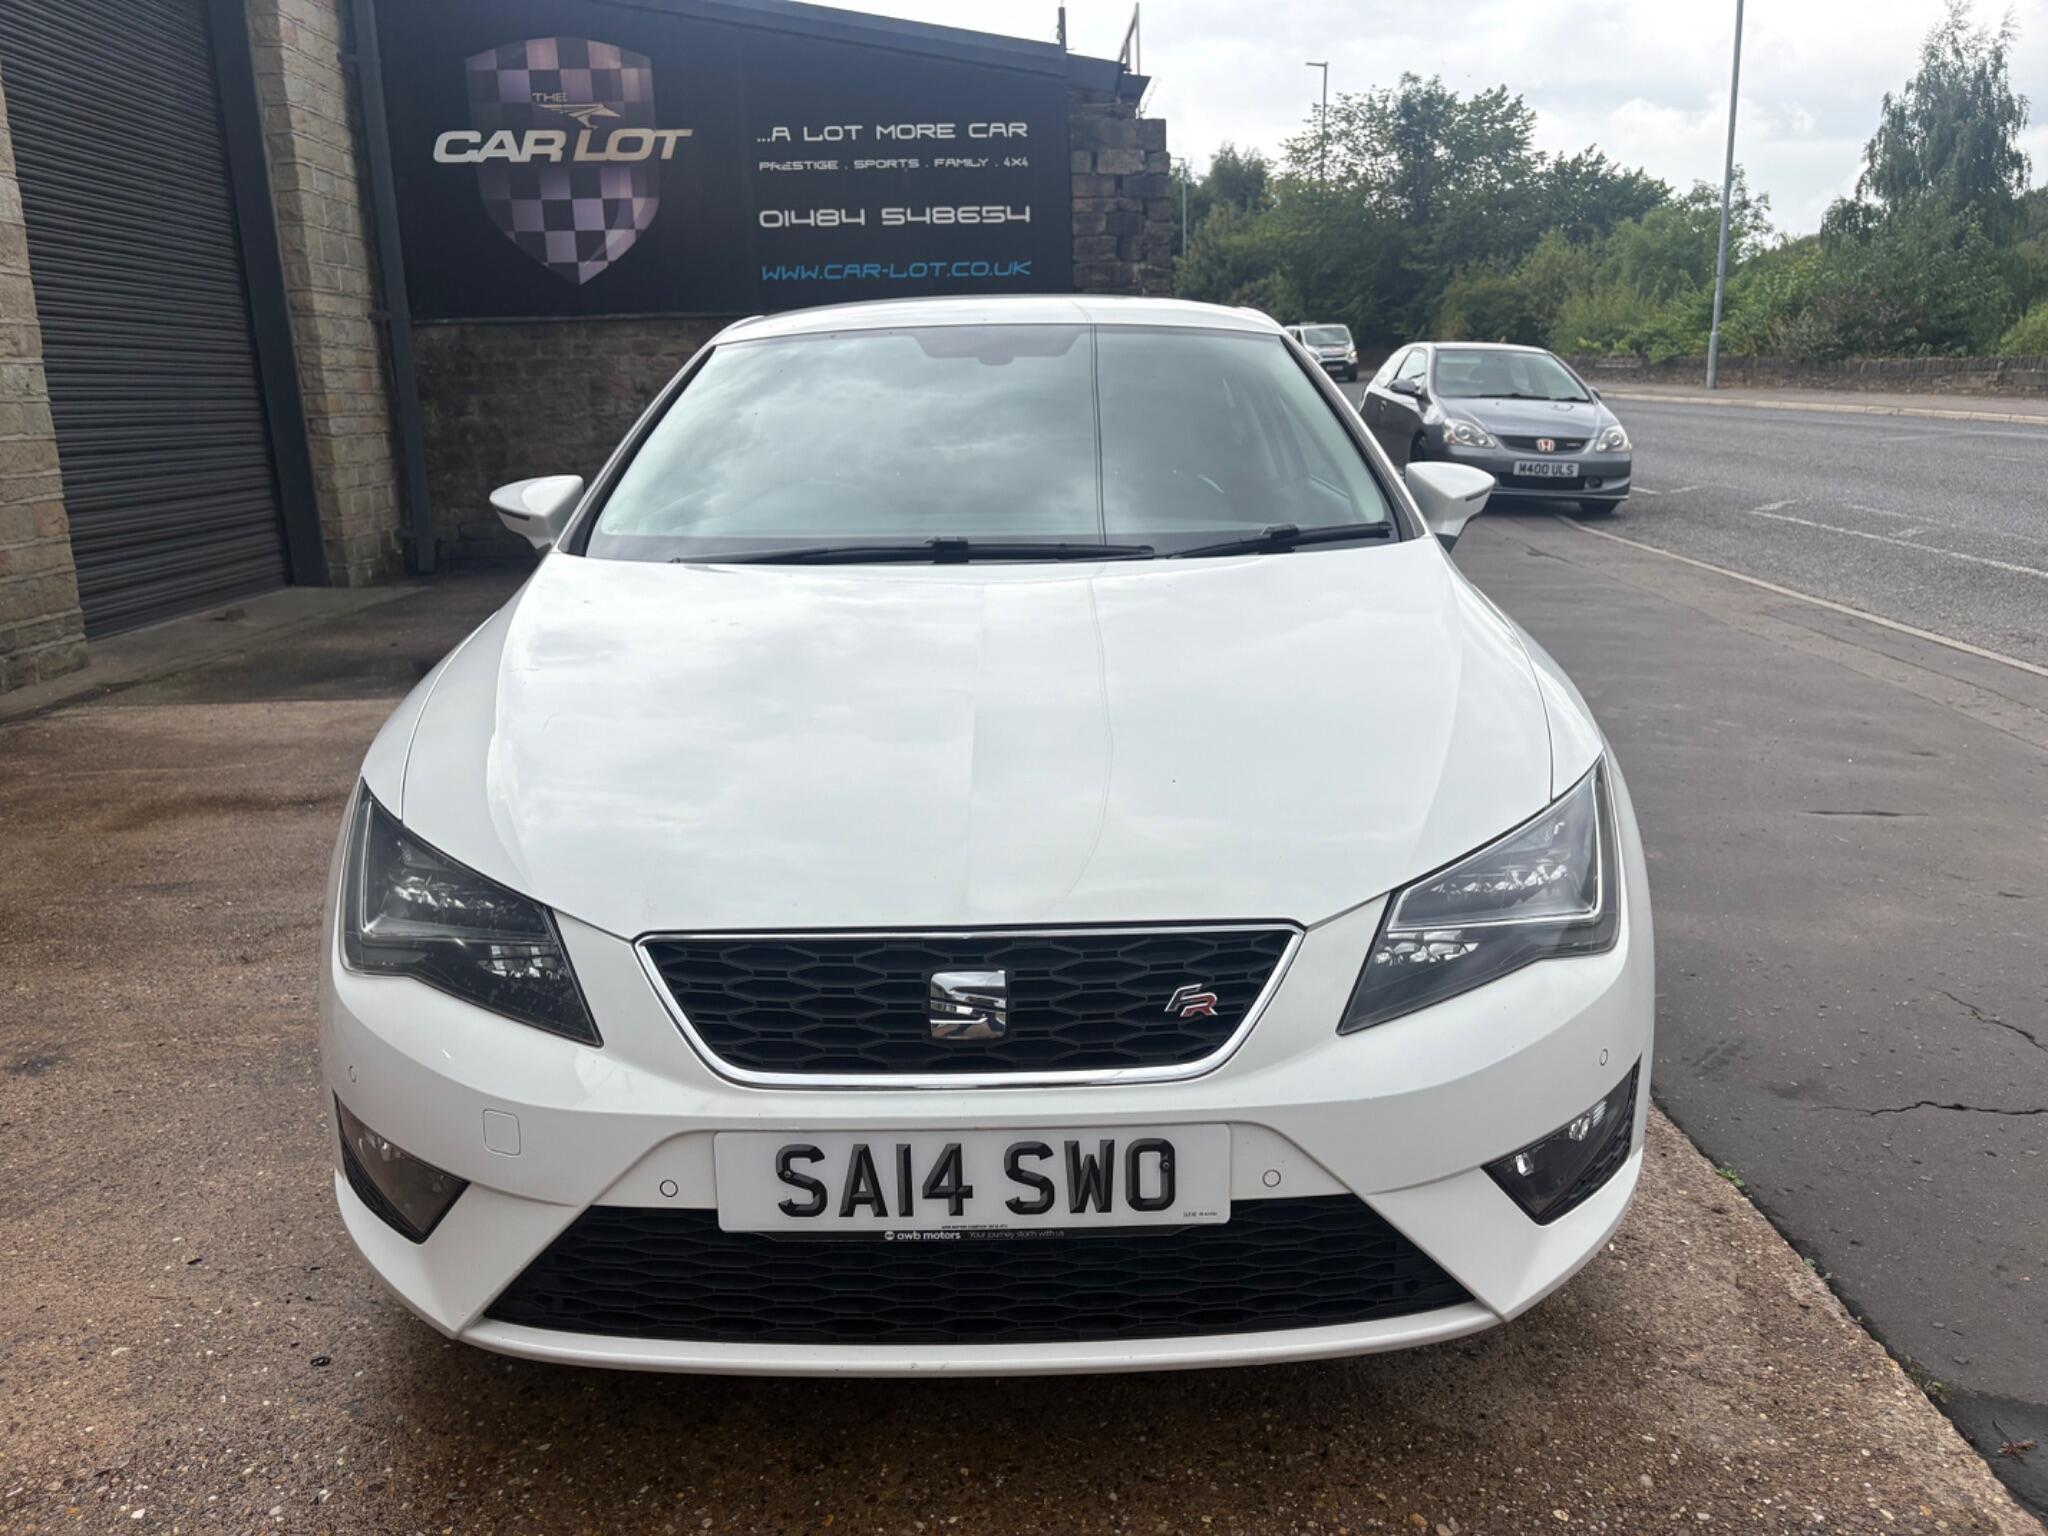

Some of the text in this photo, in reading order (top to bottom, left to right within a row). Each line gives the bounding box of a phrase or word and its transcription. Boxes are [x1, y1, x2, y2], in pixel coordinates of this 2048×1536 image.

[532, 92, 568, 103] THE
[803, 125, 864, 141] LOT
[876, 123, 956, 140] MORE
[968, 122, 1028, 138] CAR
[433, 128, 693, 163] CAR LOT
[759, 160, 839, 172] PRESTIGE
[853, 158, 920, 169] SPORTS
[934, 157, 989, 168] FAMILY
[759, 205, 1030, 227] 01484 548654
[762, 260, 1032, 280] WWW.CAR-LOT.CO.UK
[1552, 463, 1574, 475] ULS
[1164, 983, 1218, 1017] FR
[775, 1138, 1176, 1218] SA14 SWO
[897, 1230, 921, 1240] awb
[923, 1230, 961, 1240] motors
